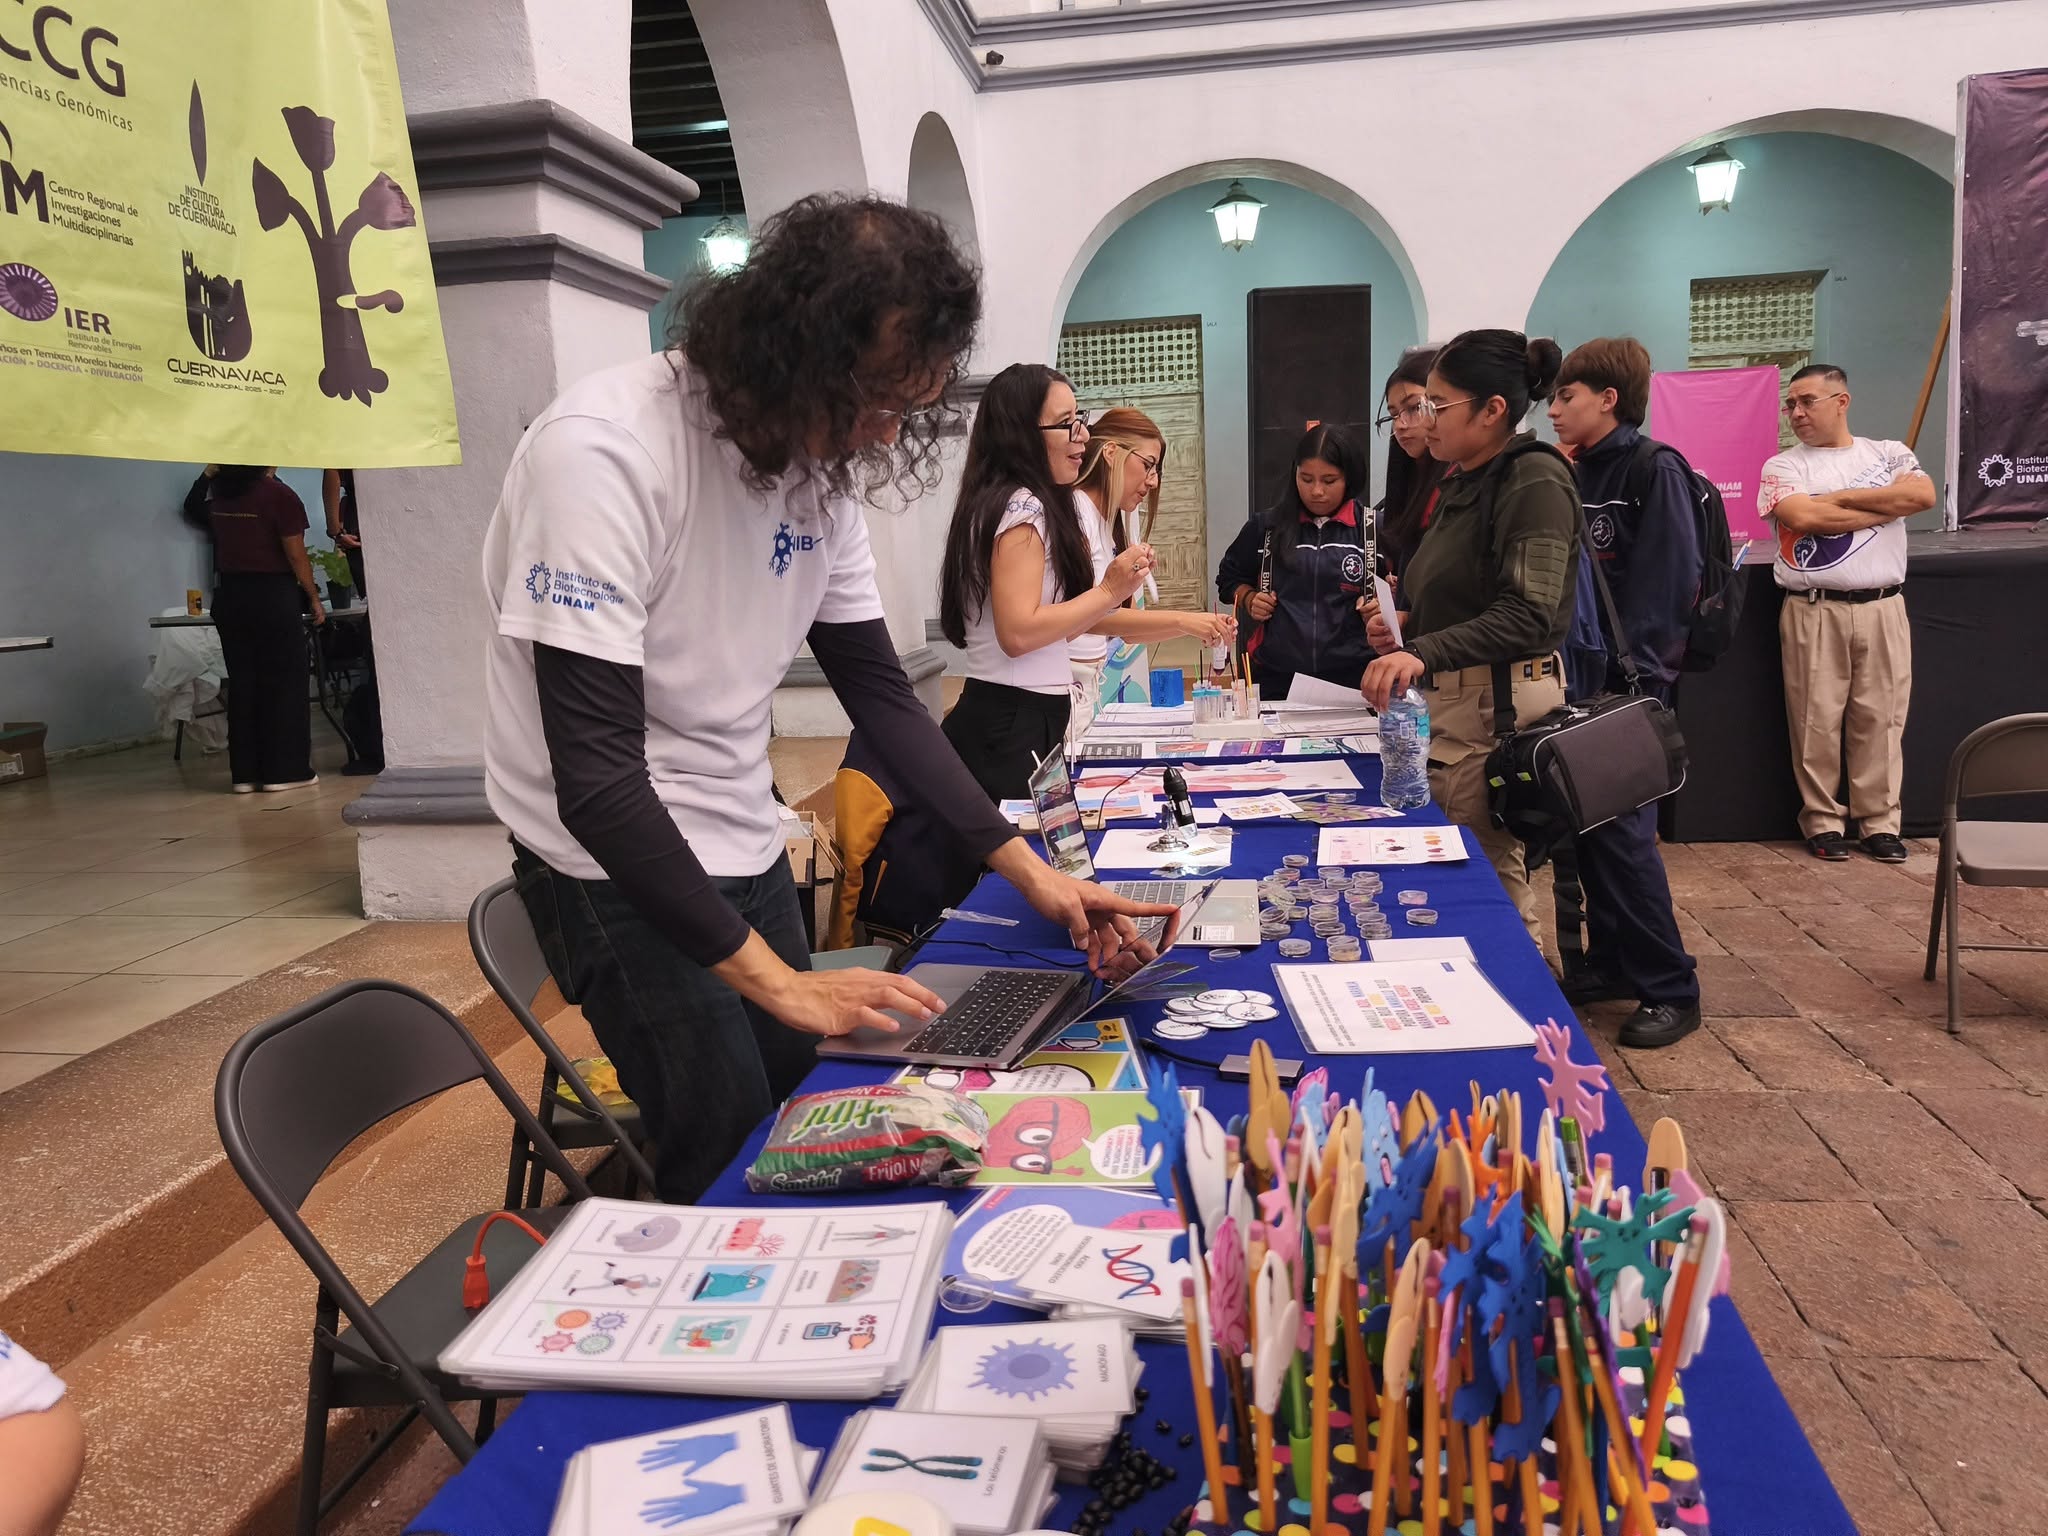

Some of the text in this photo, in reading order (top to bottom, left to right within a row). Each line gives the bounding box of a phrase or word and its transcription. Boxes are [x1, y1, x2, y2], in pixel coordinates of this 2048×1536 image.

[56, 90, 133, 132] Genómicas
[48, 180, 139, 218] Centro Regional de
[180, 193, 226, 221] DE CULTURA
[184, 184, 220, 207] INSTITUTO
[51, 196, 122, 228] Investigaciones
[168, 201, 238, 237] DE CUERNAVACA
[53, 213, 135, 247] Multidisciplinarias
[64, 306, 112, 335] IER
[67, 330, 100, 344] Instituto
[101, 337, 111, 346] de
[68, 339, 113, 354] Renovables
[20, 346, 33, 357] en
[75, 354, 108, 368] Morelos
[109, 360, 143, 373] haciendo
[37, 359, 83, 374] DOCENCIA
[167, 358, 287, 387] CUERNAVACA
[555, 568, 617, 593] Instituto de
[551, 593, 596, 612] UNAM
[868, 1156, 907, 1181] Frijol
